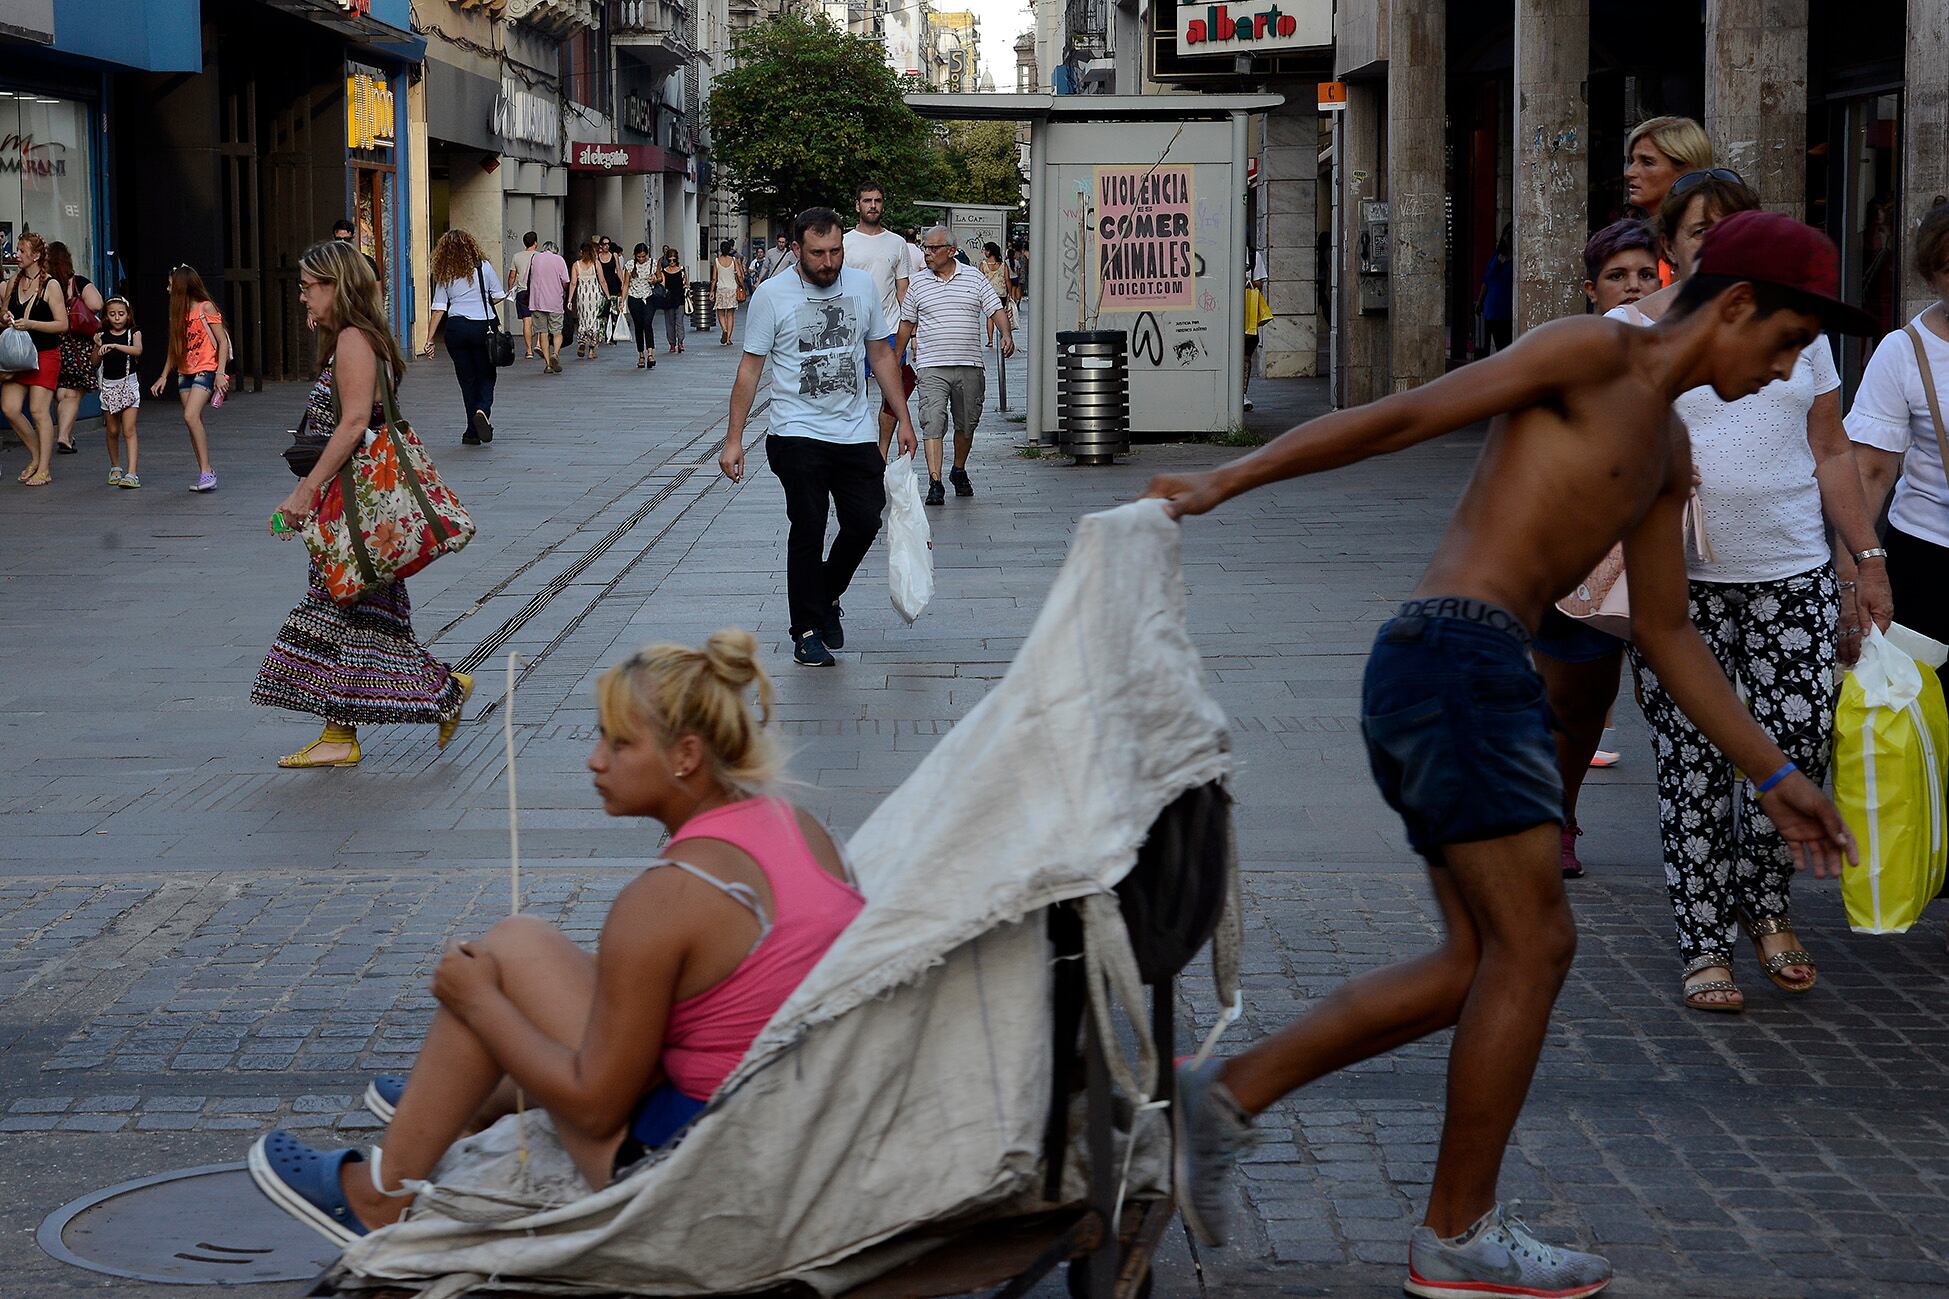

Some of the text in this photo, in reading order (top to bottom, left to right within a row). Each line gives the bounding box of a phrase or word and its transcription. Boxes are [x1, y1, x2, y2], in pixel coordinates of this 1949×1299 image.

[1186, 4, 1297, 45] alberto
[1102, 173, 1188, 206] VIOLENCIA
[1100, 213, 1189, 240] COMER
[1100, 241, 1191, 280] ANIMALES
[1110, 281, 1183, 296] VOICOT.COM
